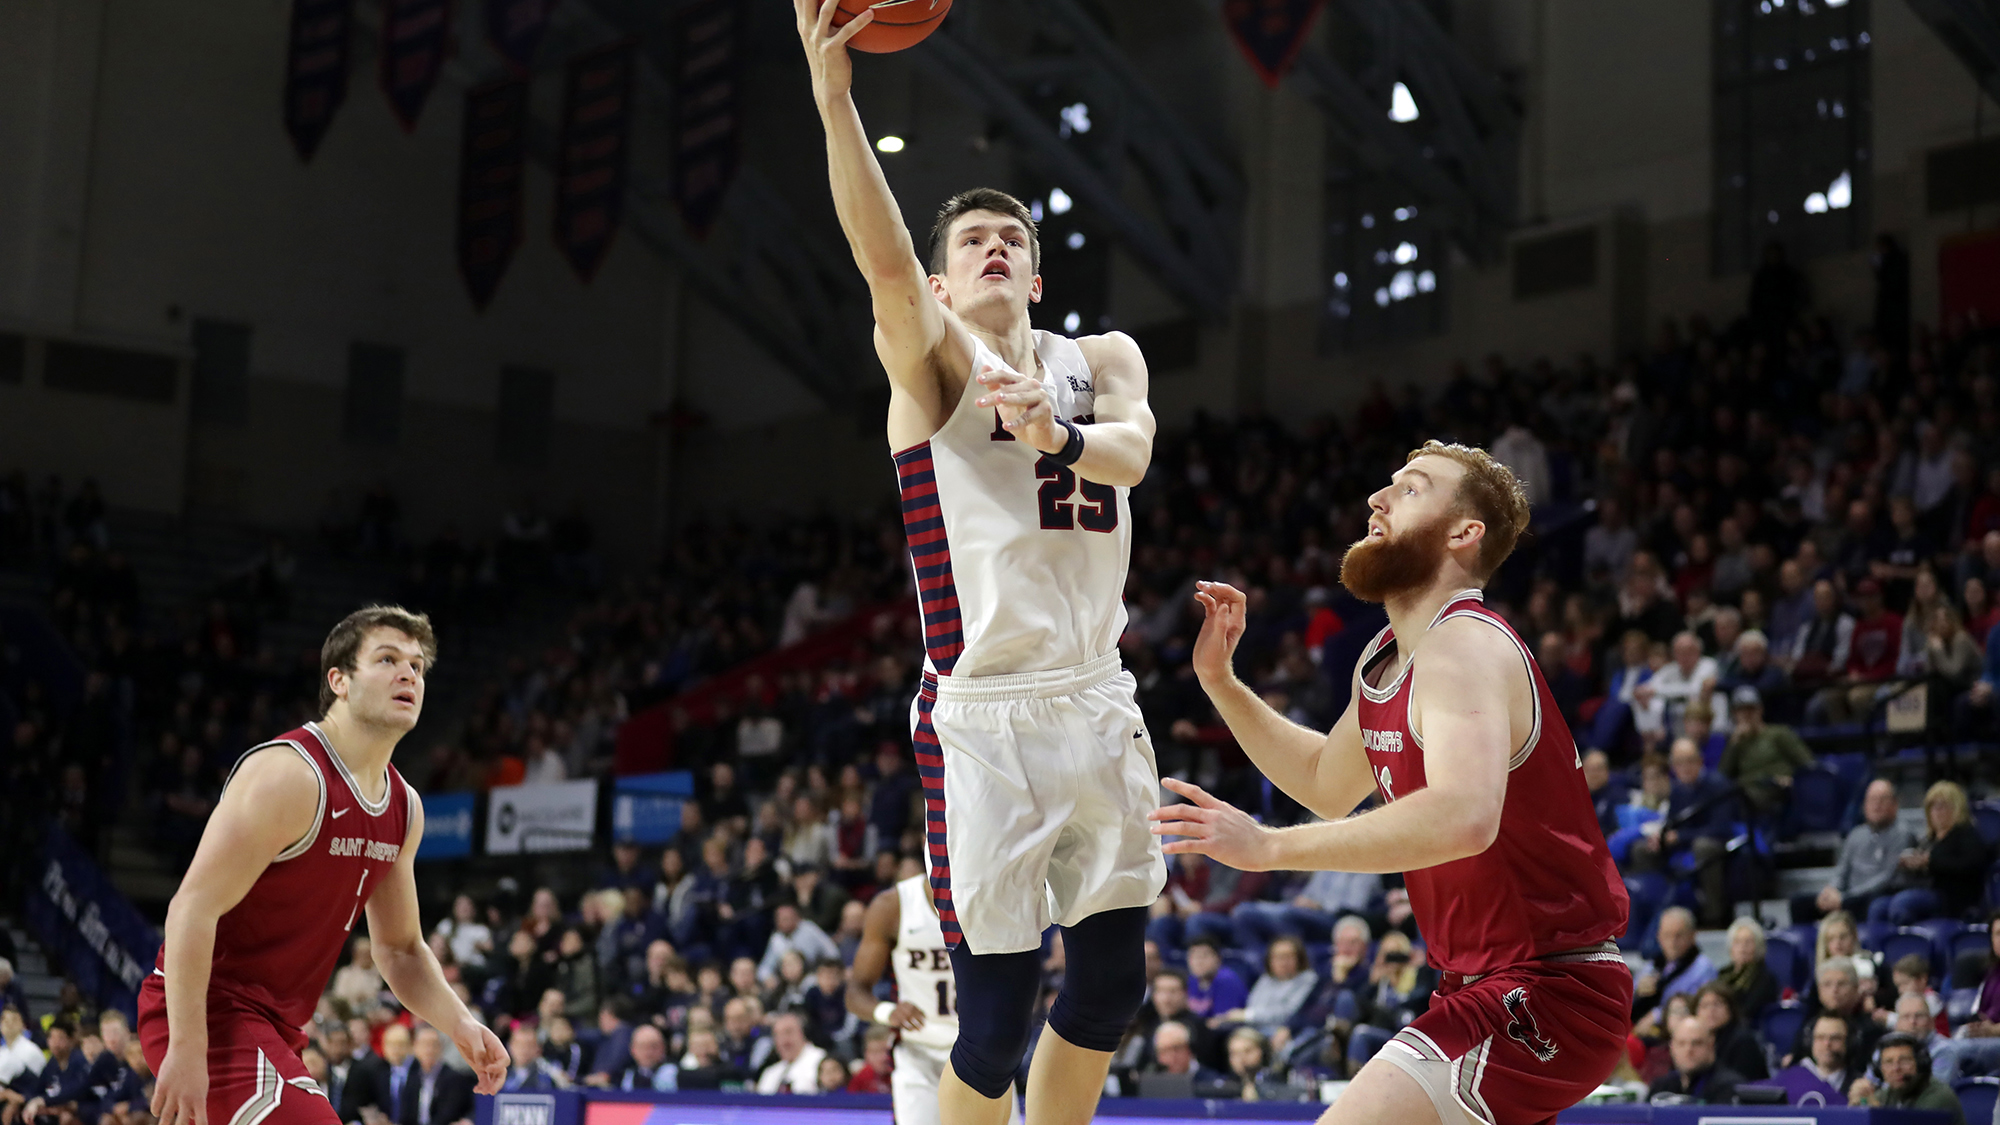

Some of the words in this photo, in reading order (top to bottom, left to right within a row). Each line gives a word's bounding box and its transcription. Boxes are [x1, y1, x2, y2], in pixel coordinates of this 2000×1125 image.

[1034, 454, 1119, 534] 25
[328, 836, 365, 857] SAINT
[907, 947, 951, 971] PE
[936, 980, 958, 1016] 1
